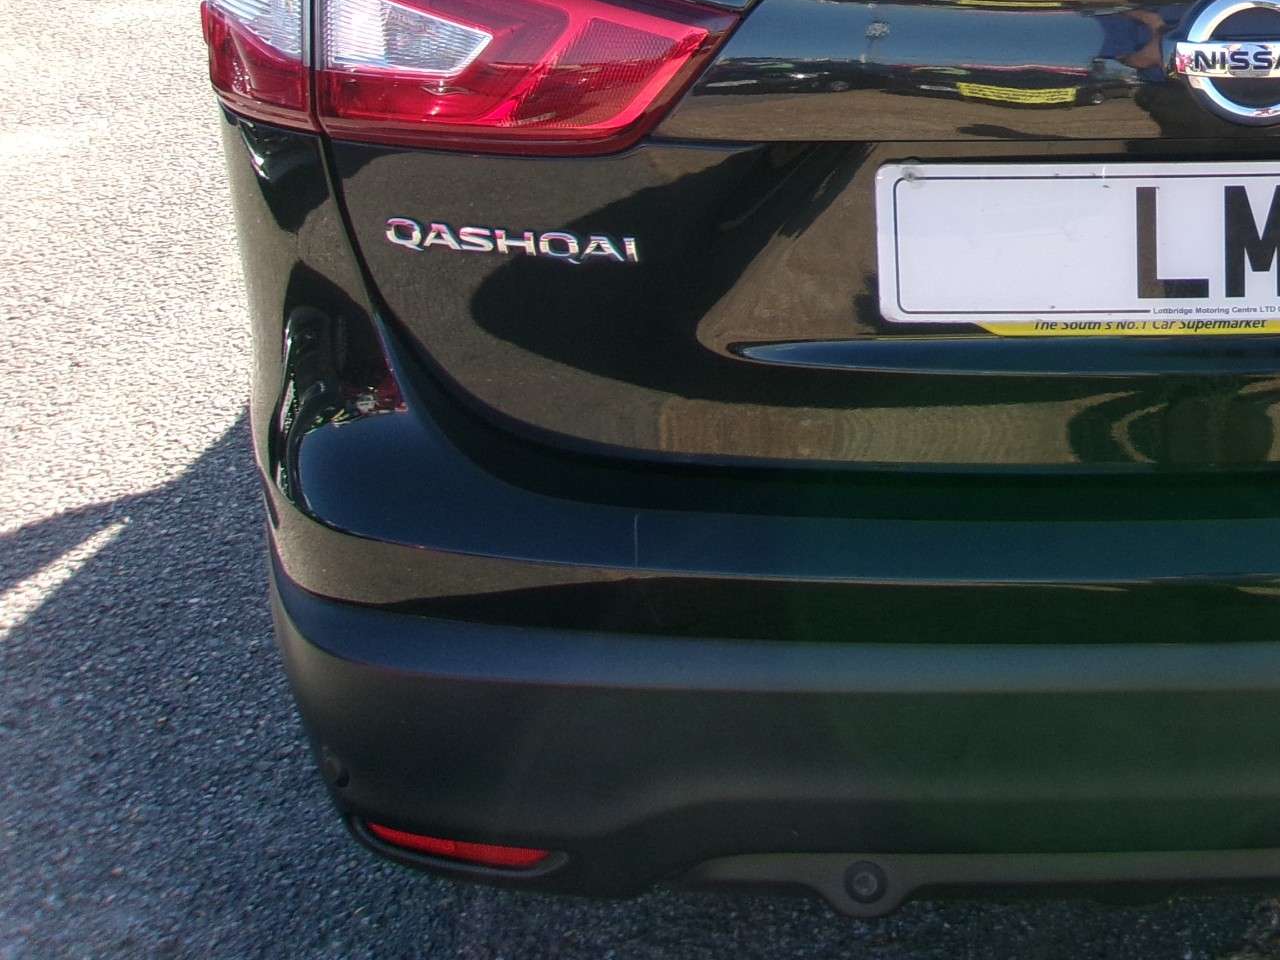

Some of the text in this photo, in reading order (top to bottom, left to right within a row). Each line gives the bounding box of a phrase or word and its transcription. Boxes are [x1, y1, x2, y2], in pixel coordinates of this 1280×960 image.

[385, 217, 640, 265] QASHQAI
[1195, 306, 1230, 315] Motoring
[1259, 305, 1276, 313] LTD
[1061, 320, 1113, 330] Souths
[1152, 319, 1177, 330] Car
[1178, 319, 1267, 332] Supermarket
